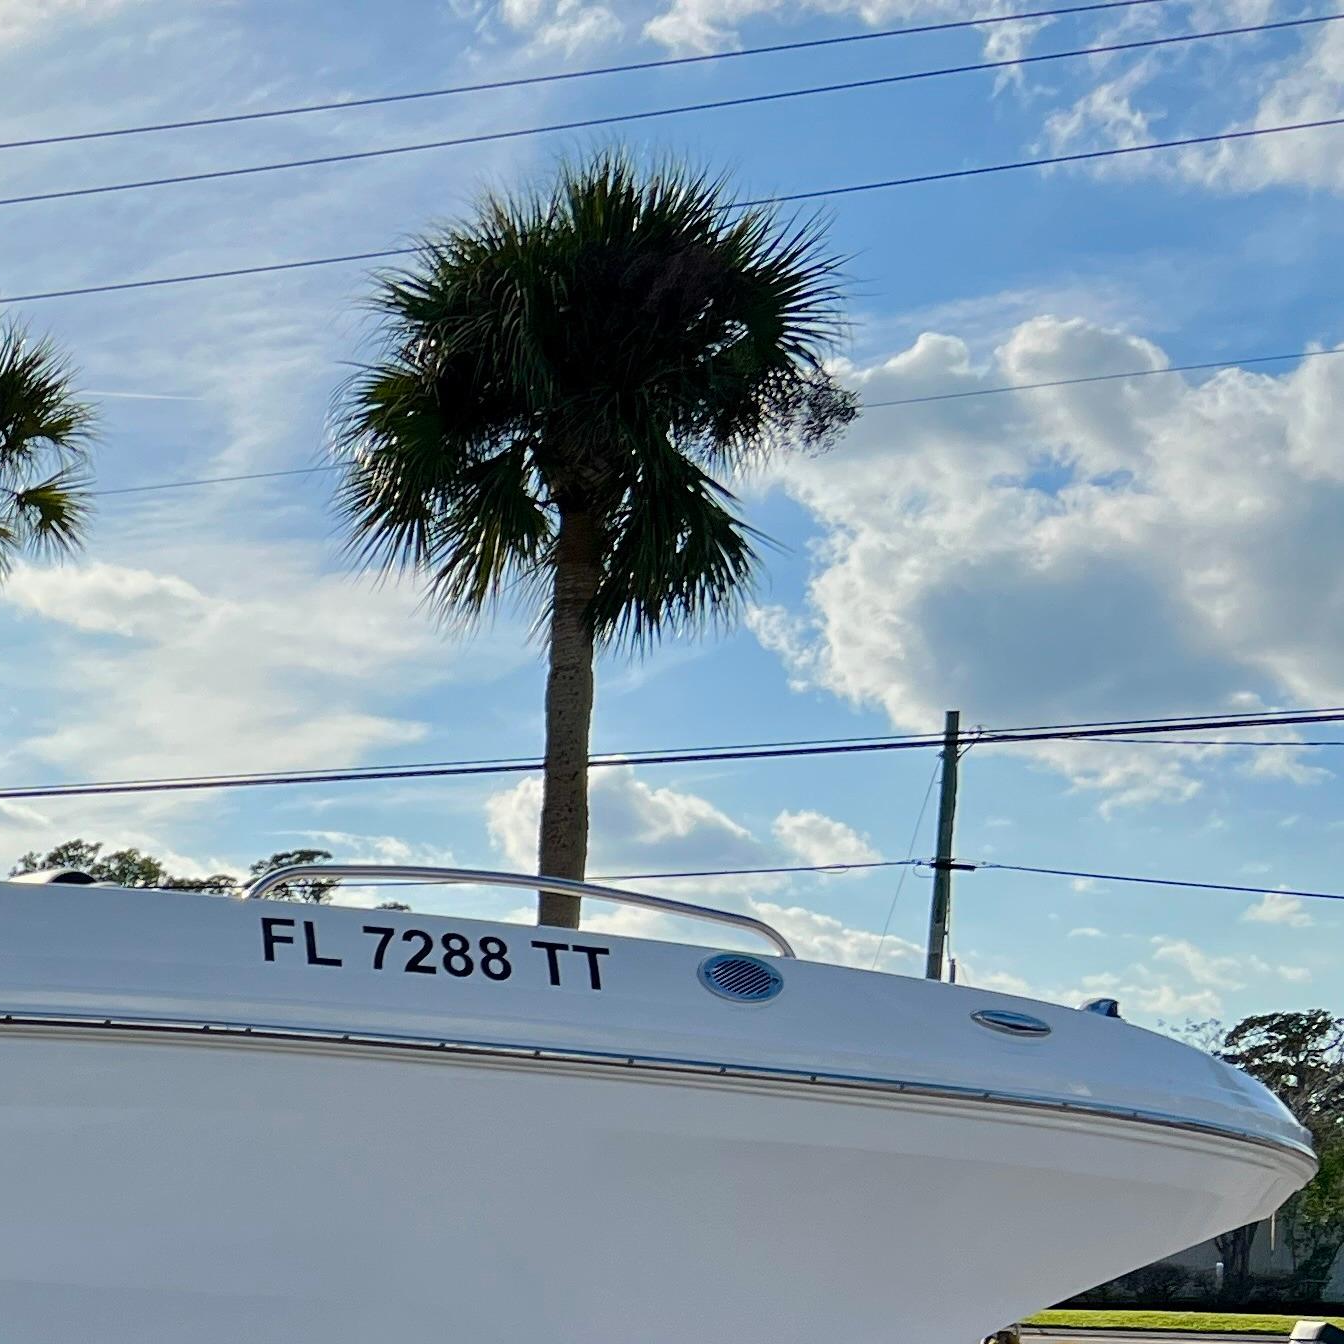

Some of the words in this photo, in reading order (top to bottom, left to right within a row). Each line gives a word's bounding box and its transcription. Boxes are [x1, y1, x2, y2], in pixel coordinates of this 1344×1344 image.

[260, 916, 343, 967] FL
[362, 926, 513, 981] 7288
[530, 940, 610, 992] TT
